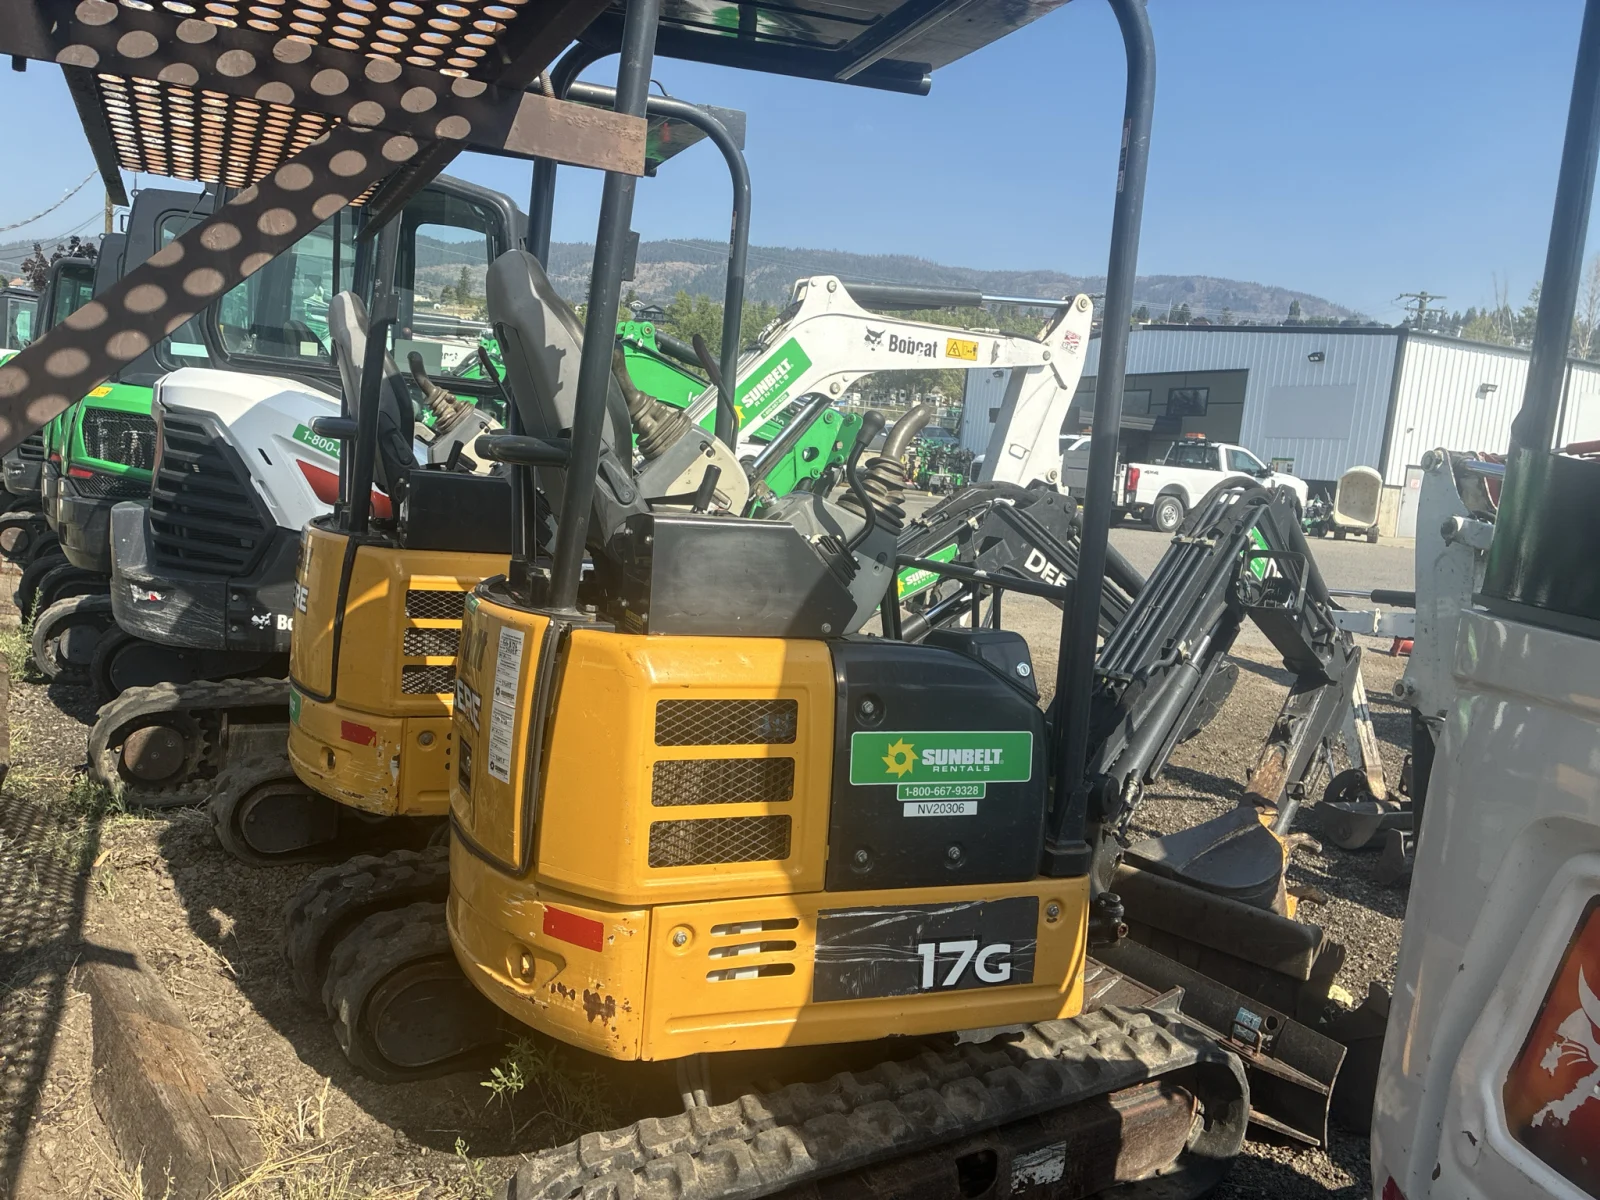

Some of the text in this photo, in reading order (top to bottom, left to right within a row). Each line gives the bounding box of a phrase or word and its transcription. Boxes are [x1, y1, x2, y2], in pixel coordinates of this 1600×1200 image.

[741, 357, 792, 409] SUNBELT
[754, 374, 790, 407] RENTALS
[922, 748, 1003, 765] SUNBELT
[932, 765, 991, 773] RENTALS
[904, 785, 979, 797] 1-800-667-9328
[917, 802, 965, 815] NV20306
[917, 939, 1011, 989] 17G
